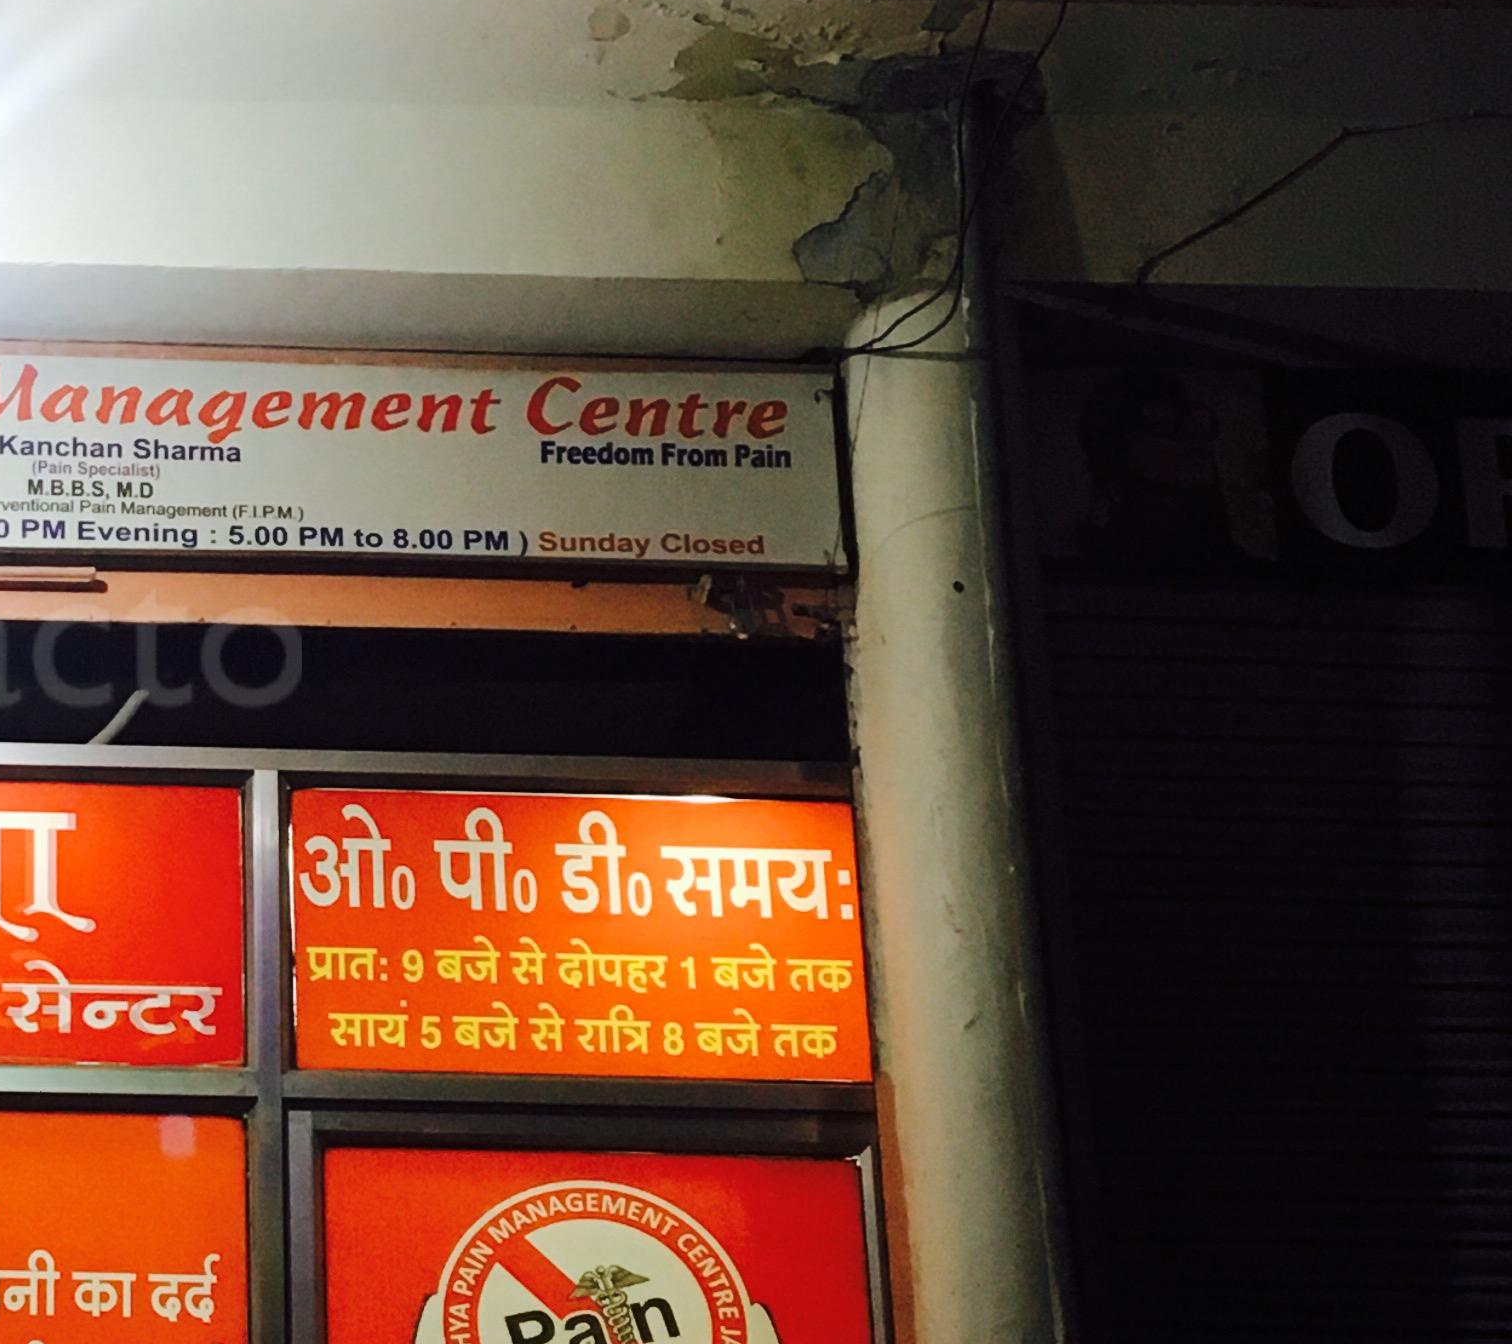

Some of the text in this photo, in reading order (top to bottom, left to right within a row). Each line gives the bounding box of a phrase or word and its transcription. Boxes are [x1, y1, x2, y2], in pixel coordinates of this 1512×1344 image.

[527, 376, 790, 439] Centre
[32, 460, 161, 480] (Pain Specialist)
[133, 439, 241, 462] Sharma
[541, 439, 792, 470] Freedom From Pain
[79, 500, 116, 514] Pain
[120, 502, 227, 520] Management
[117, 482, 154, 499] M.D
[21, 519, 66, 539] PM
[77, 520, 198, 548] Evening
[228, 525, 288, 546] 5.00
[300, 525, 346, 548] PM
[353, 526, 385, 549] to
[392, 527, 454, 550] 8.00
[463, 529, 512, 551] PM
[538, 529, 651, 561] Sunday
[660, 532, 766, 557] Closed
[403, 949, 423, 982] 9
[434, 936, 500, 985] बजे
[511, 937, 546, 986] से
[557, 938, 668, 993] दोपहर
[683, 959, 697, 990] 1
[711, 944, 776, 991] बजे
[787, 959, 852, 993] तक
[3, 961, 223, 1037] सेन्टर
[328, 999, 684, 1056] सायं 5 से रात्रि 8
[453, 1241, 494, 1296] PAIN
[489, 1192, 679, 1243] MANAGEMENT
[677, 1233, 739, 1320] CENTRE
[72, 1271, 136, 1318] का
[148, 1254, 220, 1322] दर्द
